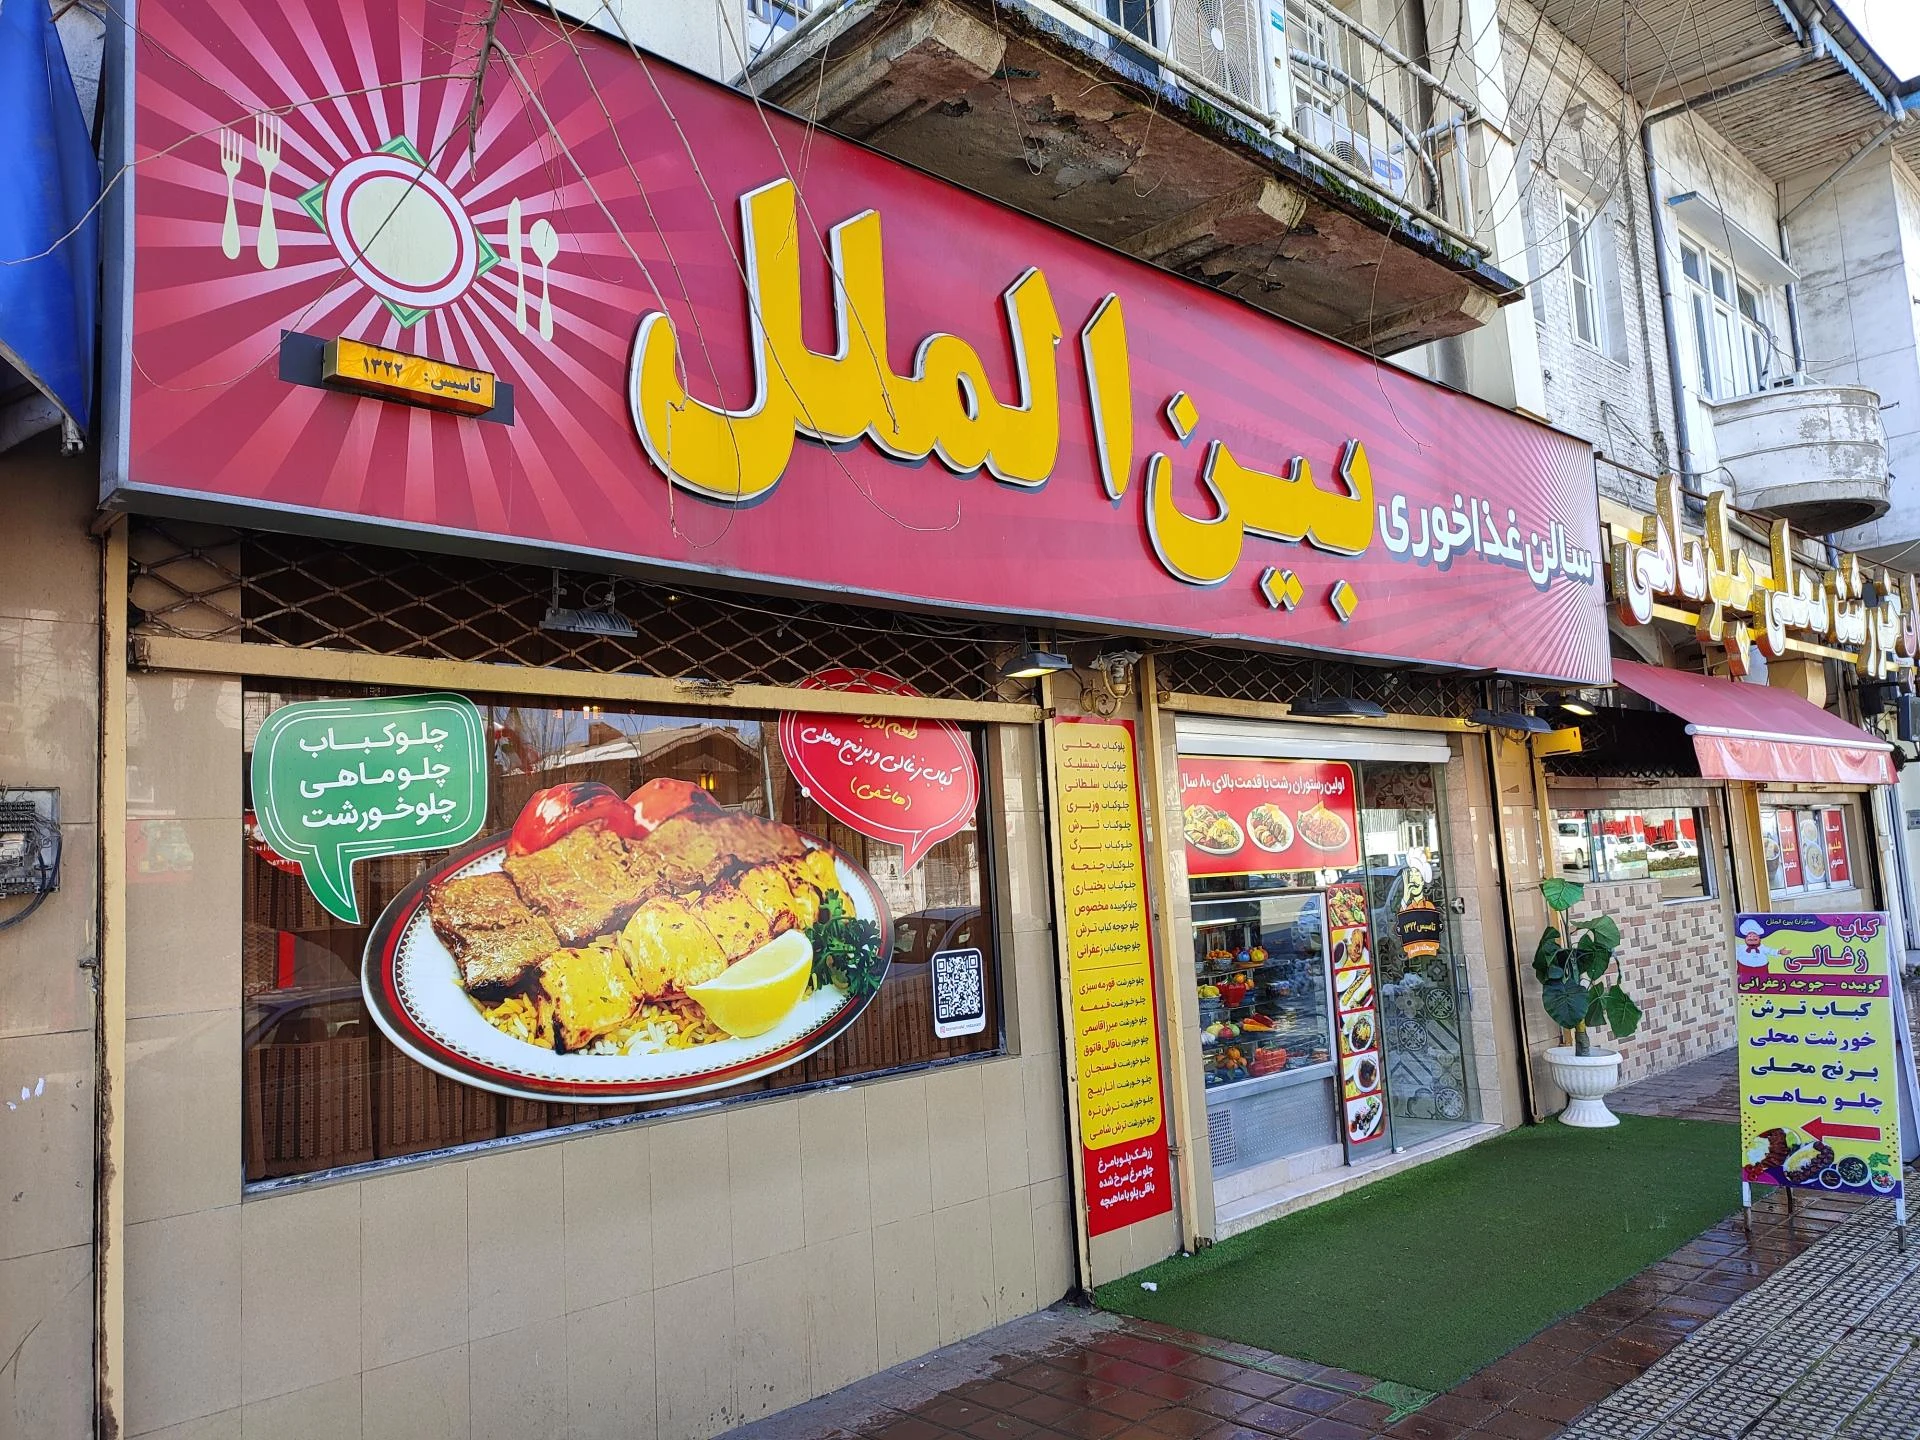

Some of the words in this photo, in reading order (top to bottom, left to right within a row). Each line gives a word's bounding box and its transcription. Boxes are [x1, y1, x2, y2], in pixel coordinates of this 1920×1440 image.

[363, 357, 403, 378] ۱۳۲۲
[1145, 390, 1375, 622] بین
[1525, 518, 1593, 584] سالن
[801, 728, 841, 747] محلی
[1062, 738, 1100, 751] محلی
[879, 753, 924, 781] زغالی
[922, 766, 962, 791] کباب
[1065, 778, 1099, 792] سلطانی
[1180, 773, 1198, 792] سال
[1200, 773, 1211, 788] ۸۰
[1212, 773, 1234, 793] بالای
[1270, 776, 1292, 794] رشت
[1293, 776, 1324, 794] رستوران
[1324, 777, 1345, 794] اولین
[1067, 801, 1099, 813] وزیری
[1069, 819, 1099, 833] ترش
[1070, 837, 1102, 854] برگ
[1071, 861, 1105, 874] چنجه
[1073, 881, 1105, 895] بختیاری
[1074, 901, 1108, 916] مخصوص
[1076, 923, 1097, 937] ترش
[1838, 919, 1879, 942] کباب
[1077, 944, 1103, 958] زعفرانی
[1785, 945, 1868, 973] زغالی
[1740, 977, 1786, 991] زعفرانی
[1841, 979, 1882, 993] کوبیده
[1080, 999, 1110, 1011] قیمه
[1752, 1000, 1806, 1018] ترش
[1812, 1001, 1871, 1021] کباب
[1750, 1028, 1798, 1047] محلی
[1805, 1031, 1876, 1051] خورشت
[1085, 1059, 1116, 1077] فسنجان
[1751, 1057, 1816, 1076] محلی
[1822, 1060, 1879, 1082] برنج
[1750, 1088, 1827, 1105] ماهی
[1833, 1092, 1883, 1114] چلو
